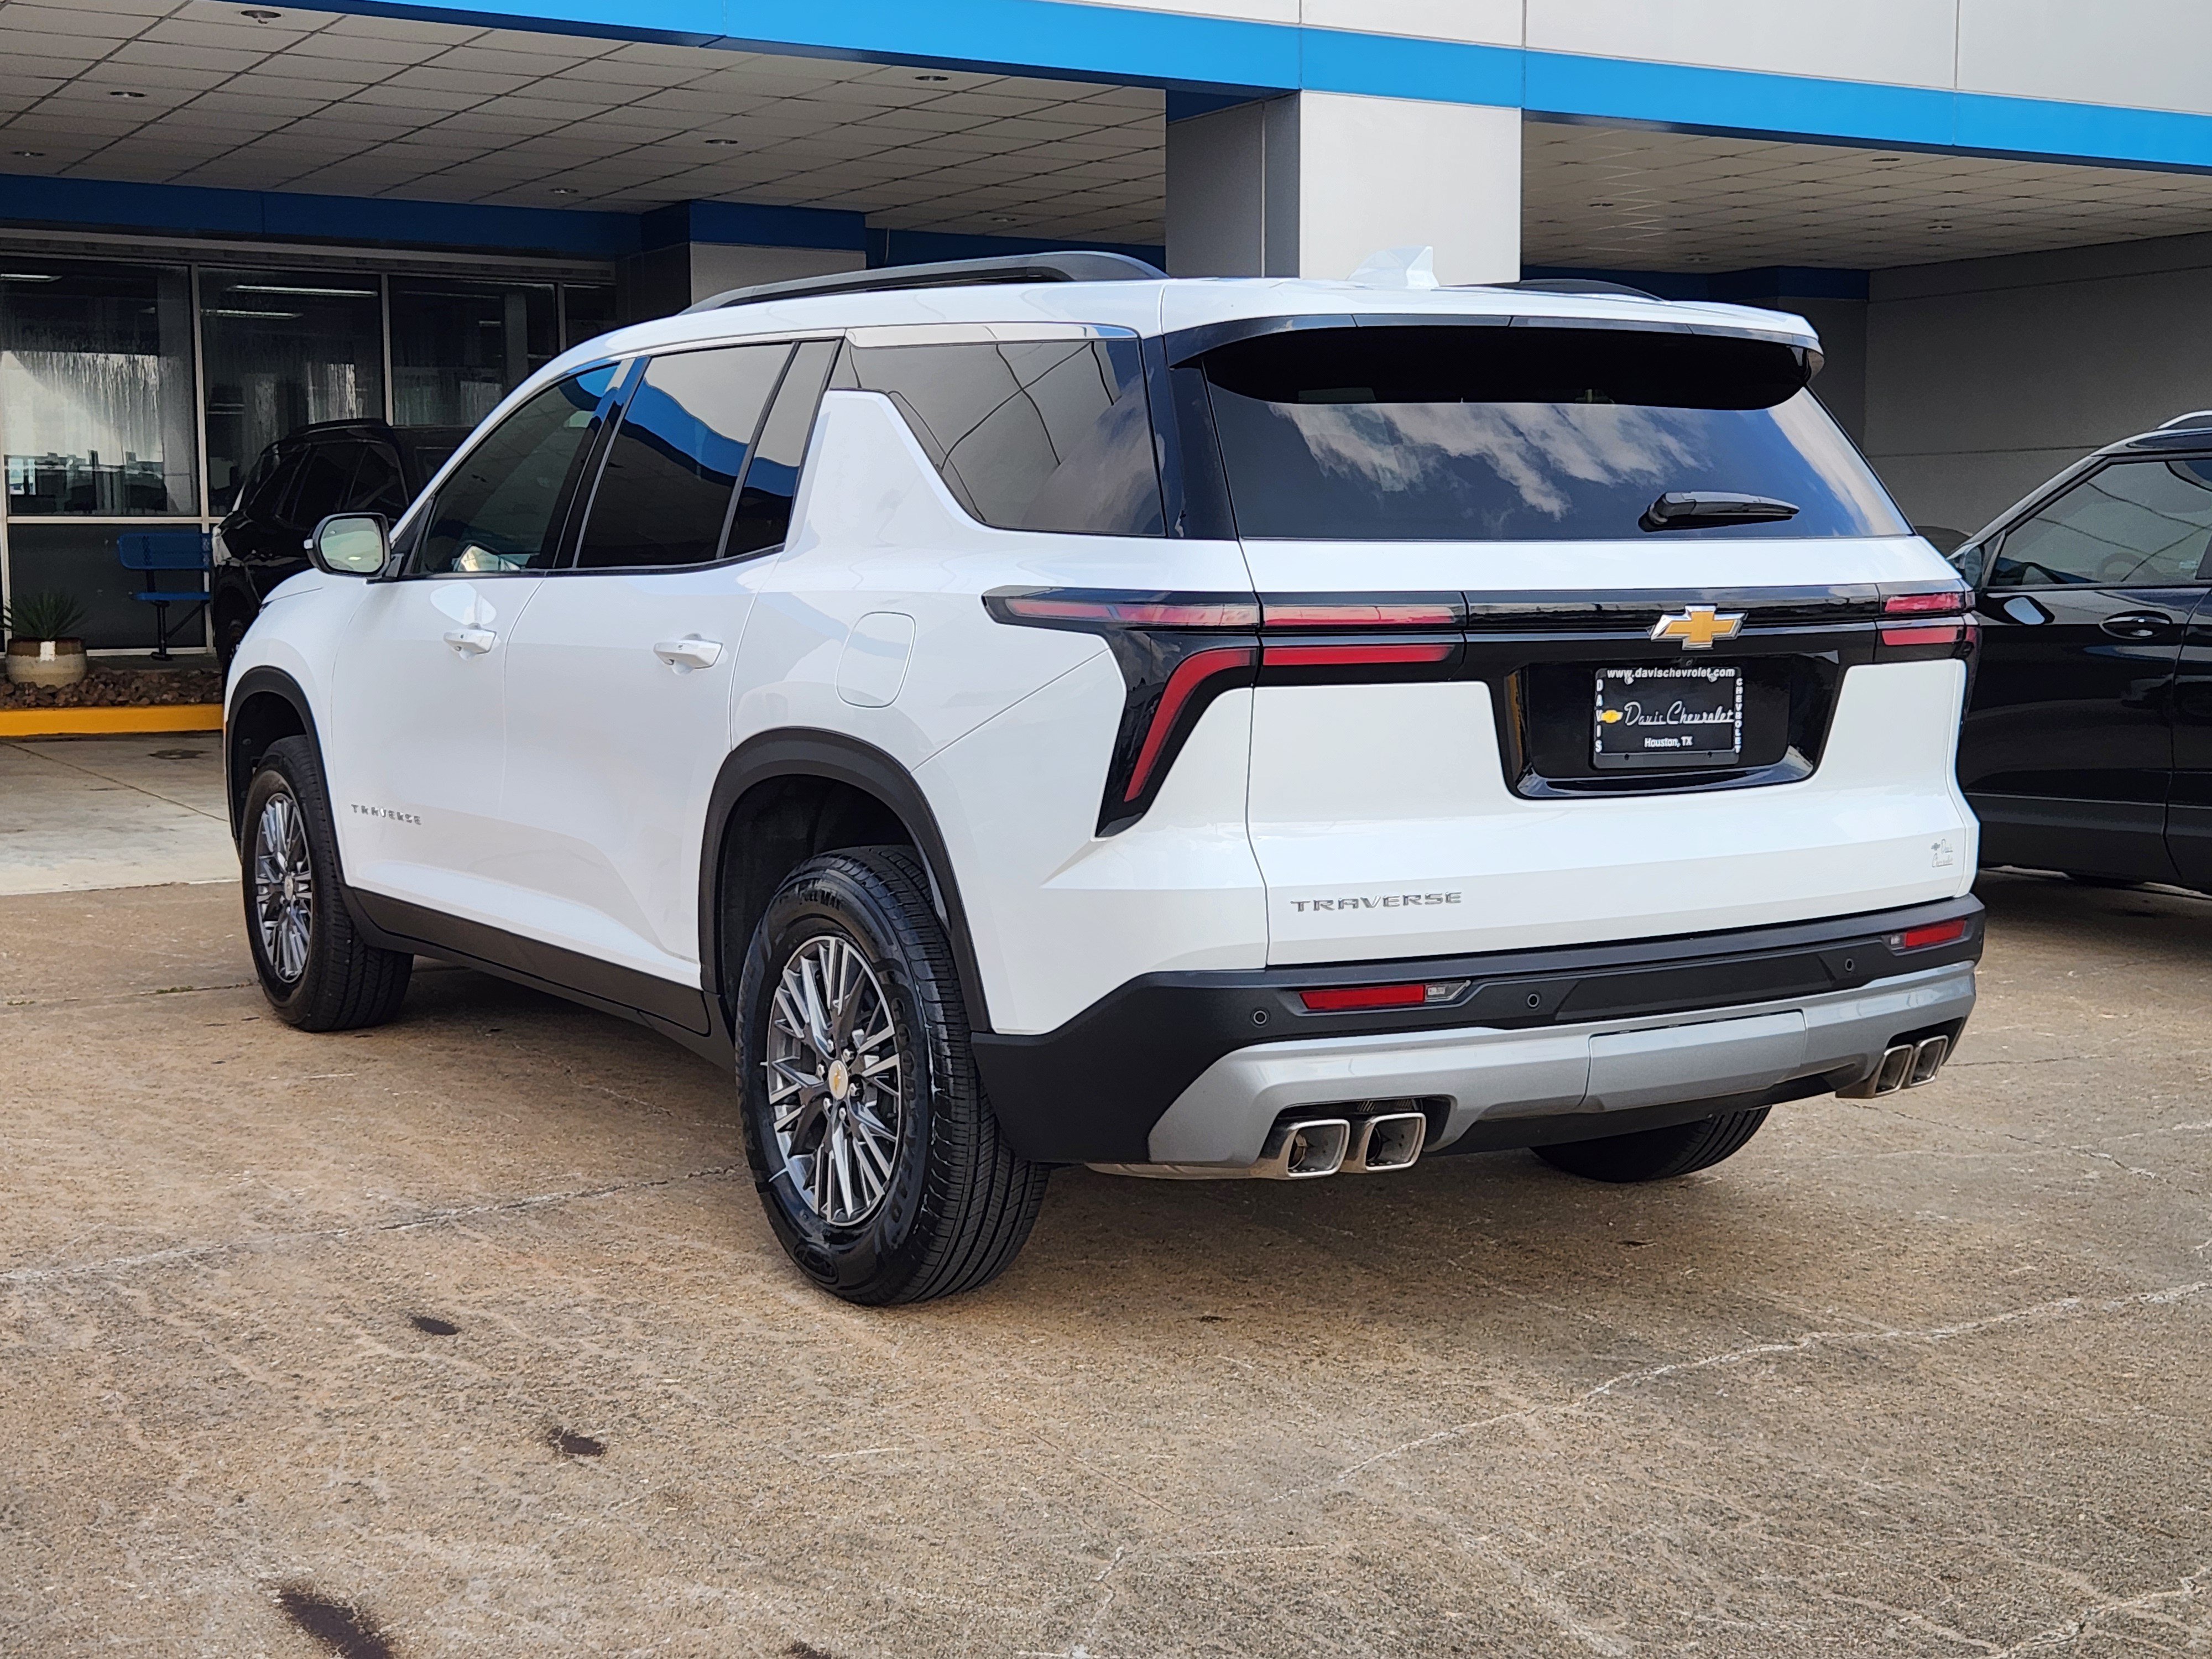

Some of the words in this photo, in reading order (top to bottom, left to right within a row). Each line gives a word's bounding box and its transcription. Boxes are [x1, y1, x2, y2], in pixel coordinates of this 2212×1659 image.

[1607, 667, 1735, 678] www.davischevrolet.com
[1595, 679, 1603, 753] DAVIS
[1624, 701, 1666, 726] Davis
[1666, 700, 1734, 725] Chevrolet
[1735, 678, 1743, 753] CHEVROLET
[1644, 737, 1681, 748] Houston,
[1681, 736, 1693, 747] TX
[1290, 891, 1462, 912] TRAVERSE
